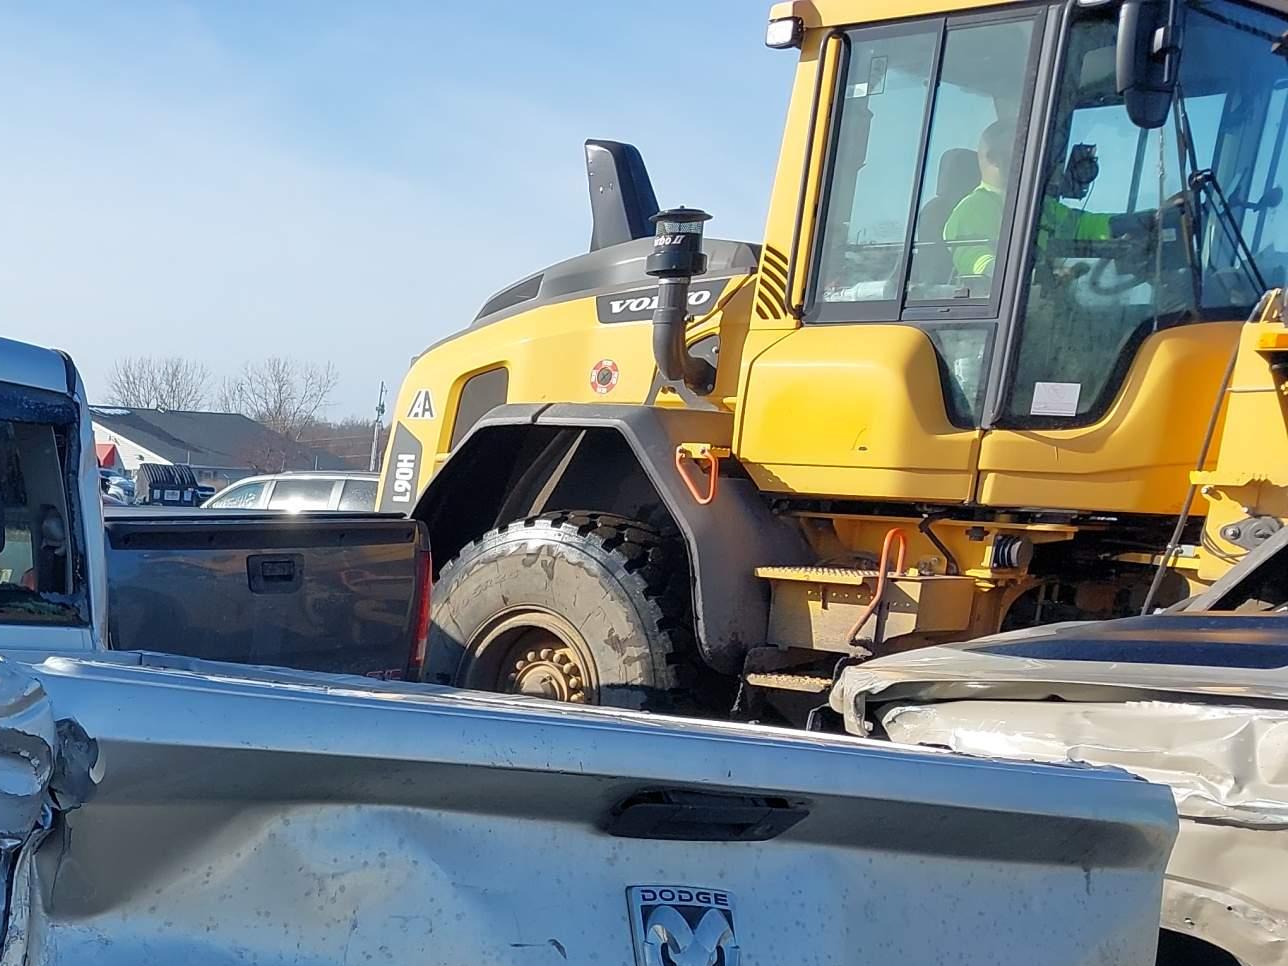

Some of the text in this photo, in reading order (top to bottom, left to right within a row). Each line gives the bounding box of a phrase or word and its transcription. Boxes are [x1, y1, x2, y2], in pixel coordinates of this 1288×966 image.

[609, 290, 711, 314] VOLO
[392, 453, 416, 503] L90H
[640, 889, 729, 905] DODGE
